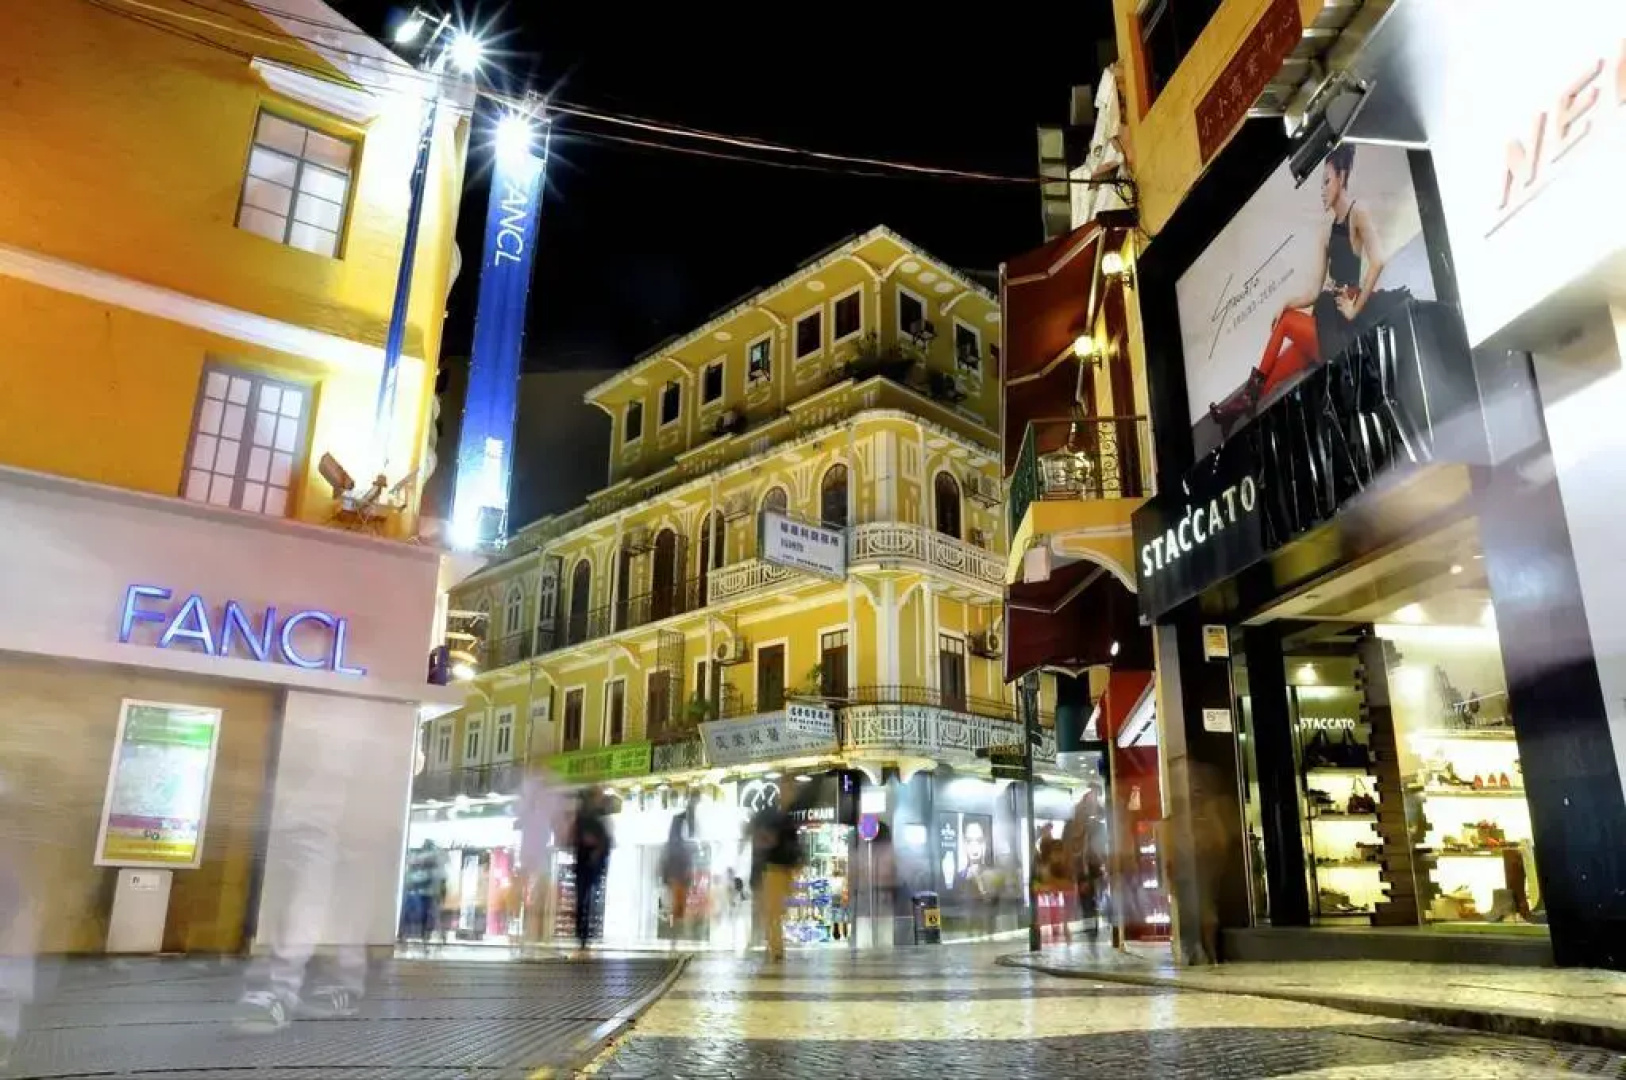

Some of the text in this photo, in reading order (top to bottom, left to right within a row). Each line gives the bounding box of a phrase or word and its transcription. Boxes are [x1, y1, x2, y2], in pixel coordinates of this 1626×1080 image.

[1499, 38, 1626, 210] NE
[495, 180, 528, 267] ANCL
[1142, 476, 1256, 577] STACCATO
[118, 584, 368, 676] FANCL
[1300, 718, 1356, 731] STACCATO
